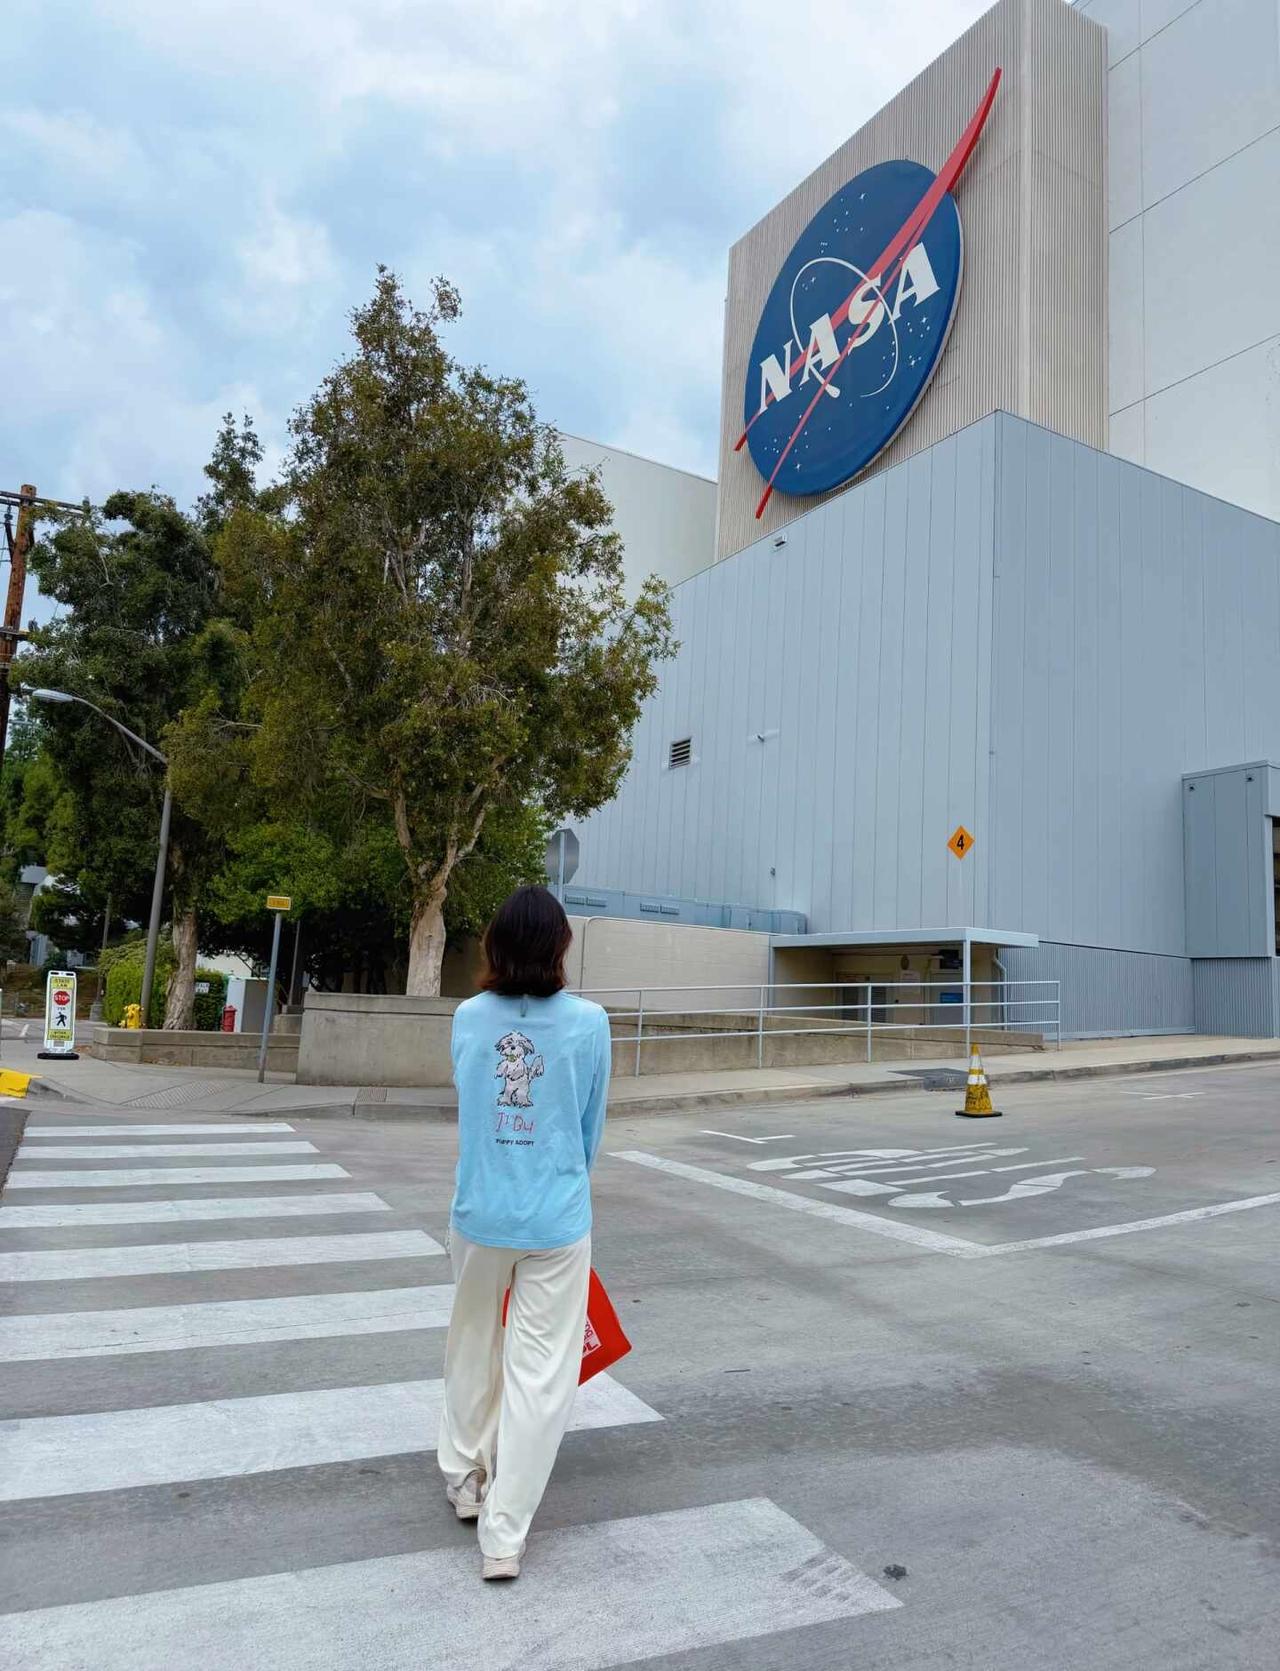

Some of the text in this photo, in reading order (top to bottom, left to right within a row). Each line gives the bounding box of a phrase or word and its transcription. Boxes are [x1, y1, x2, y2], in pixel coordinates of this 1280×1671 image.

[759, 242, 941, 414] NASA
[957, 834, 965, 850] 4
[746, 1142, 1157, 1208] STOP
